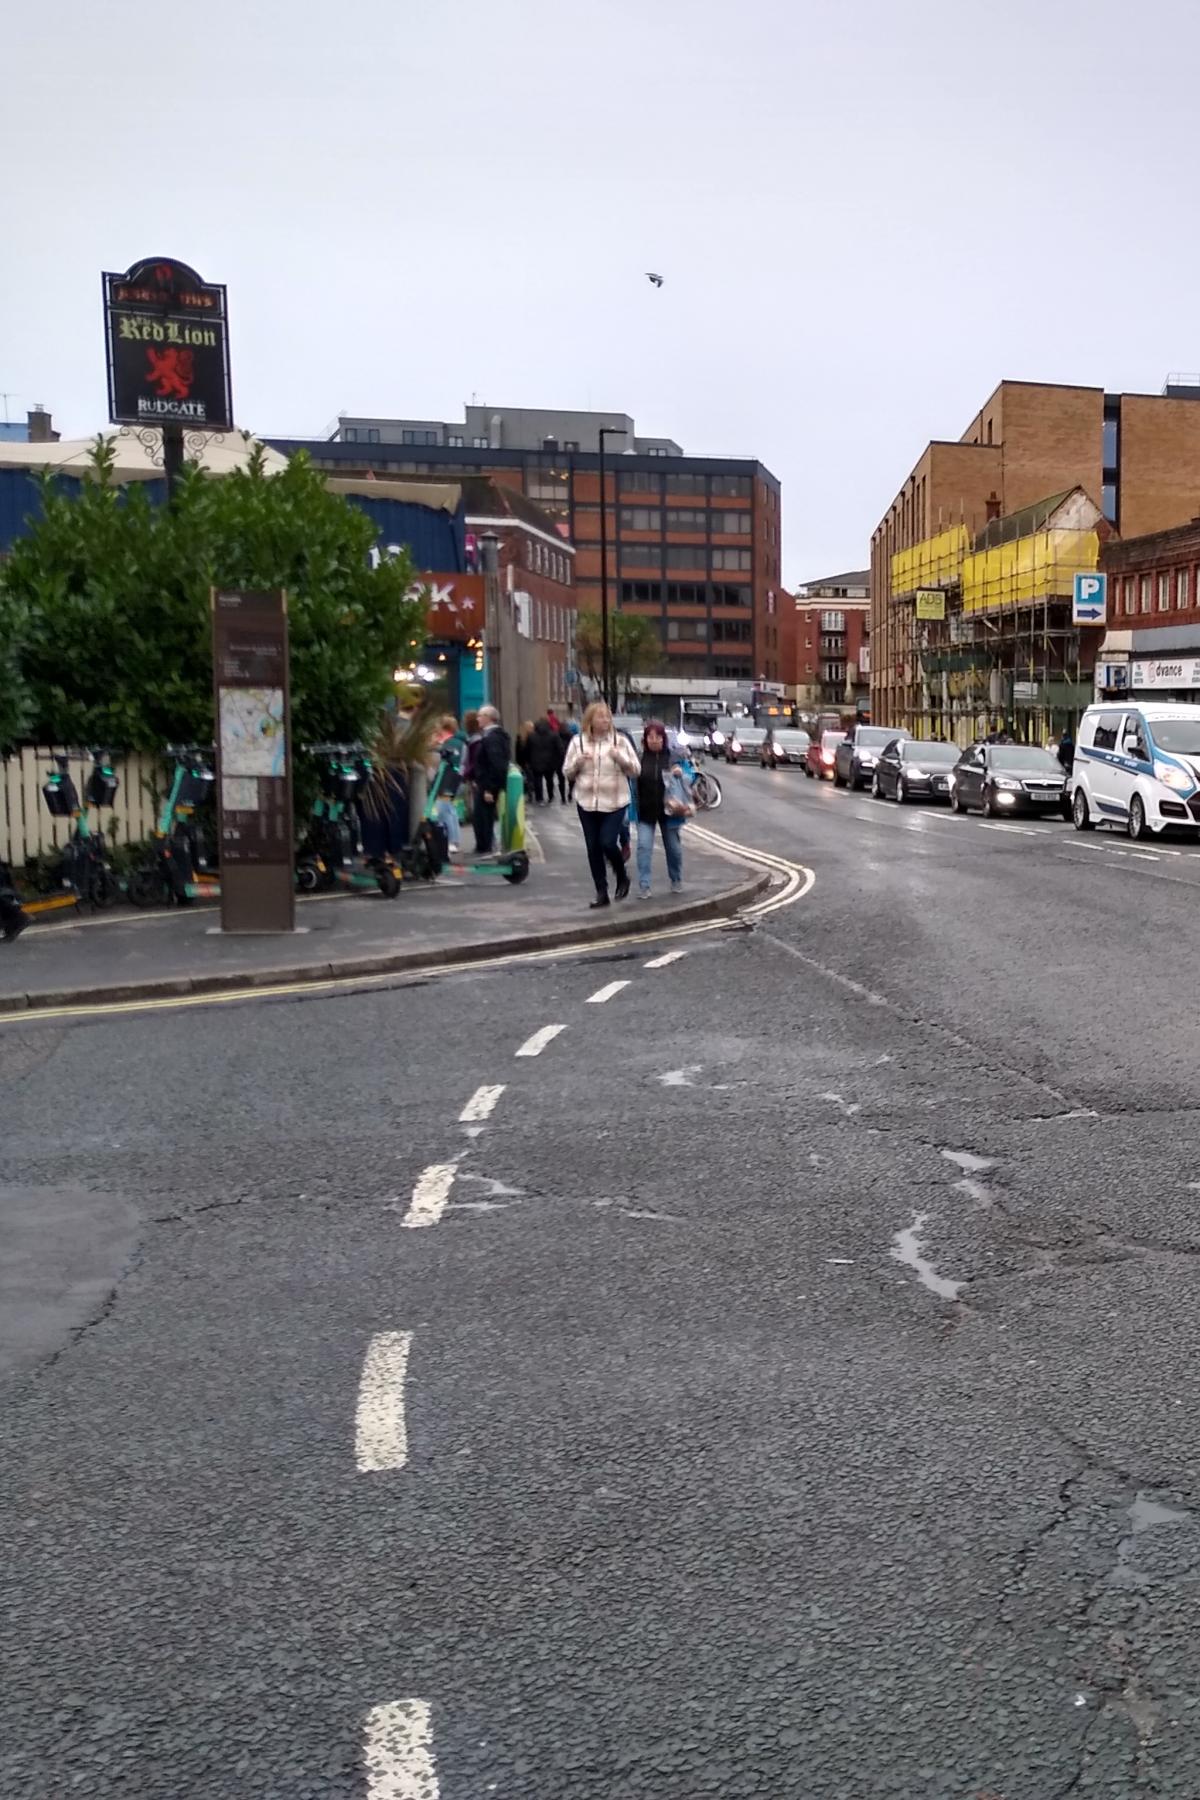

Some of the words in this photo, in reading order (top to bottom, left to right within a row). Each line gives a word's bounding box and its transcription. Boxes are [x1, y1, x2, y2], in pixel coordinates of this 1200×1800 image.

[119, 316, 164, 341] Red
[164, 321, 216, 346] Lion
[138, 398, 206, 417] RUDGATE
[1081, 578, 1100, 600] P
